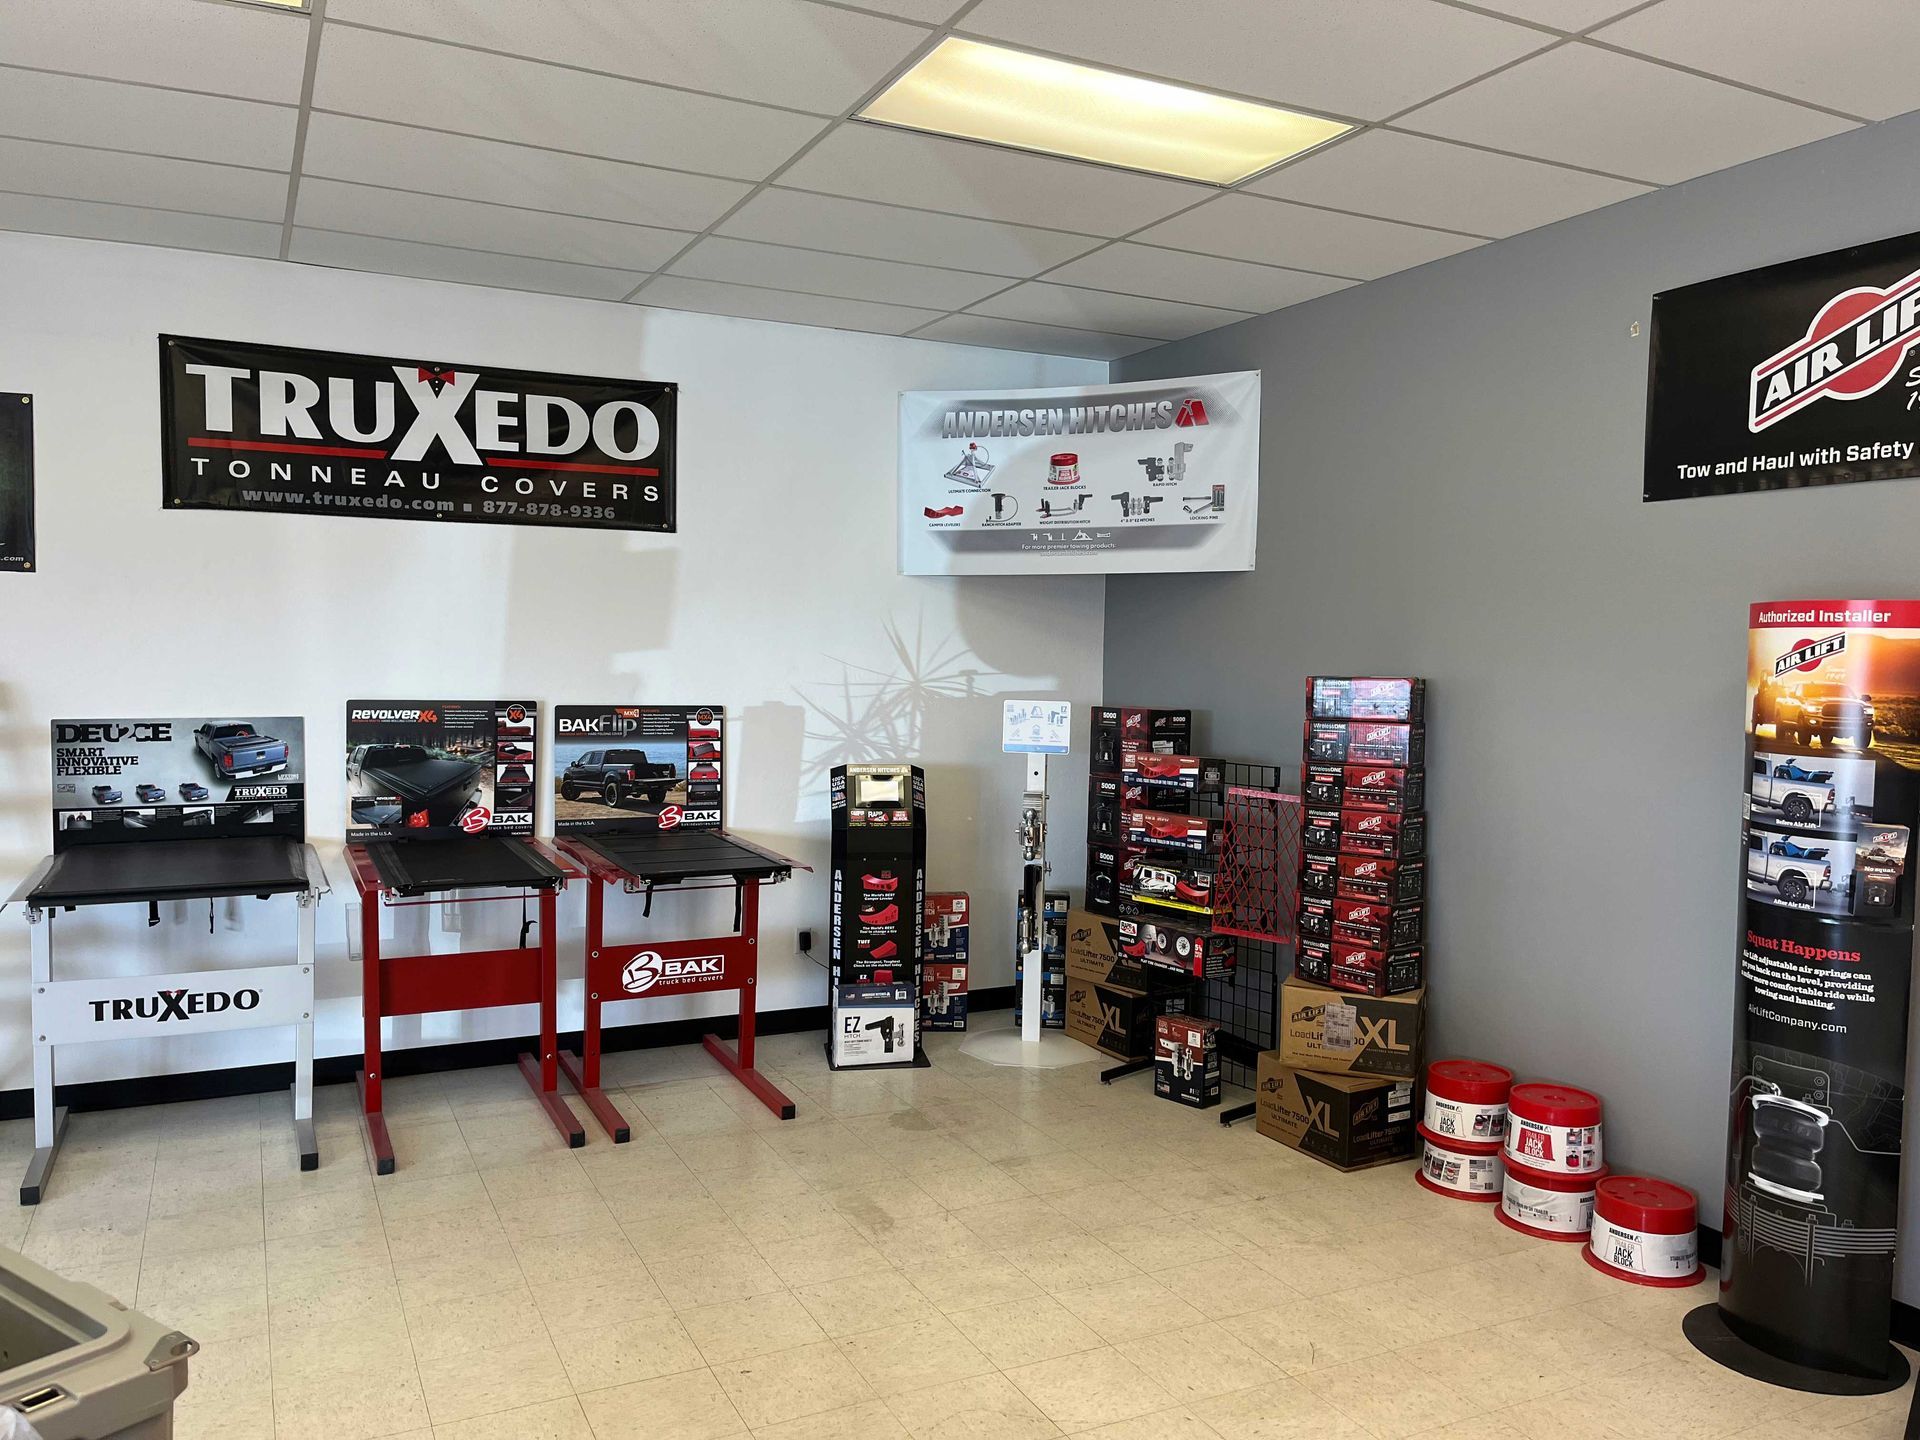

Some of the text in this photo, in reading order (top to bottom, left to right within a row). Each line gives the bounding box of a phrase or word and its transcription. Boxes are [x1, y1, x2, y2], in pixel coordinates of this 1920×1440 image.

[1763, 291, 1920, 411] AIR LIF
[186, 362, 660, 467] TRUXEDO
[942, 400, 1173, 439] ANDERSEN HITCHES
[1677, 440, 1915, 480] Tow and Haul with Safety
[190, 457, 659, 502] TONNEAU COVERS
[241, 489, 616, 520] www.truxedo.com 877-878-9336
[1047, 544, 1070, 552] premier
[1069, 543, 1090, 551] towing
[1758, 610, 1892, 624] Authorized Installer
[1777, 637, 1843, 673] AIR LIFT
[559, 714, 638, 738] BAKFlip
[57, 748, 104, 758] SMART
[57, 756, 139, 767] INNOVATIVE
[57, 765, 122, 776] FLEXIBLE
[234, 785, 288, 798] TRUXEDO
[492, 815, 529, 824] BAK
[684, 812, 718, 821] BAK
[1776, 818, 1817, 829] Before Air Lift
[1100, 853, 1114, 861] 5000
[1774, 898, 1811, 909] After Air Lift
[833, 869, 843, 960] ANDERSEN
[914, 868, 923, 958] ANDERSEN
[1747, 930, 1861, 962] Squat Happens
[1071, 946, 1115, 963] LoadLifter 7500
[664, 958, 720, 976] BAK
[1758, 956, 1798, 972] adjustable
[1799, 965, 1814, 974] air
[1813, 967, 1852, 980] springs
[1852, 973, 1872, 981] can
[659, 978, 679, 986] truck
[698, 974, 724, 982] covers
[1756, 965, 1771, 976] back
[1771, 971, 1781, 979] on
[1782, 972, 1797, 981] the
[1797, 974, 1824, 987] level,
[1824, 980, 1875, 993] providing
[1753, 975, 1769, 986] more
[1769, 979, 1823, 997] comfortable
[1824, 990, 1846, 1000] ride
[1846, 993, 1876, 1003] while
[88, 988, 260, 1023] TRUXEDO
[914, 964, 922, 1043] HITCHES
[1755, 986, 1836, 1011] towing and hauling.
[844, 1016, 861, 1034] EZ
[1102, 1001, 1127, 1036] XL
[1748, 1003, 1847, 1034] AirLiftCompany.com
[1360, 1016, 1410, 1051] XL
[1260, 1099, 1310, 1125] LoadLifter 7500
[1435, 1101, 1456, 1110] ANDERSEN
[1271, 1114, 1299, 1129] ULTIMATE
[1305, 1095, 1340, 1138] XL
[1440, 1117, 1455, 1128] JACK
[1440, 1124, 1455, 1135] BLOCK
[1520, 1119, 1544, 1131] ANDERSEN
[1353, 1129, 1384, 1143] LoadLifter
[1525, 1130, 1545, 1141] TRAILER
[1524, 1137, 1544, 1151] JACK
[1524, 1146, 1544, 1158] BLOCK
[1608, 1227, 1634, 1241] ANDERSEN
[1614, 1246, 1634, 1260] JACK
[1615, 1240, 1635, 1251] TRAILER
[1613, 1255, 1634, 1269] BLOCK
